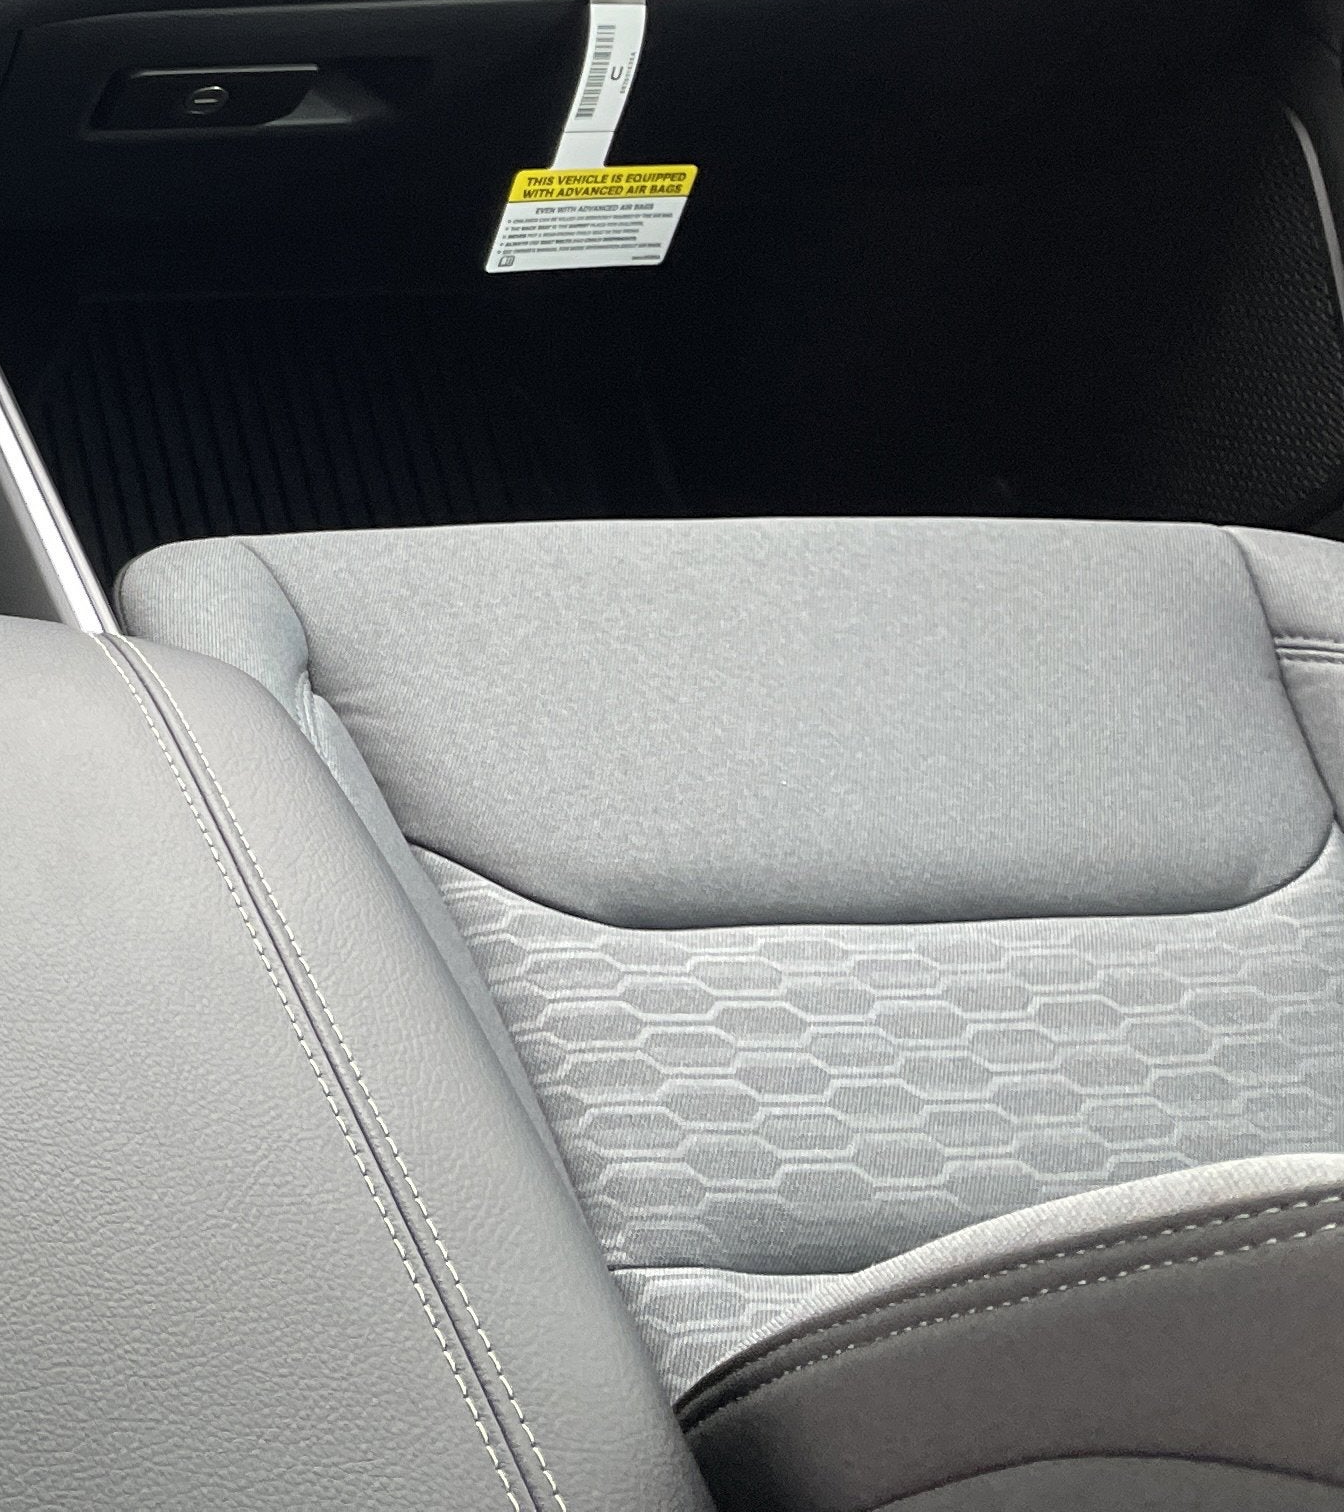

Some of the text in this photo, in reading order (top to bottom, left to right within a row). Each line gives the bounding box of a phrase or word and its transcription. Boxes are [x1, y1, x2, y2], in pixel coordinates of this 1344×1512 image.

[527, 172, 688, 187] THIS VEHICLE IS EQUIPPED
[523, 184, 683, 199] WITH ADVANCED AIR BAGS
